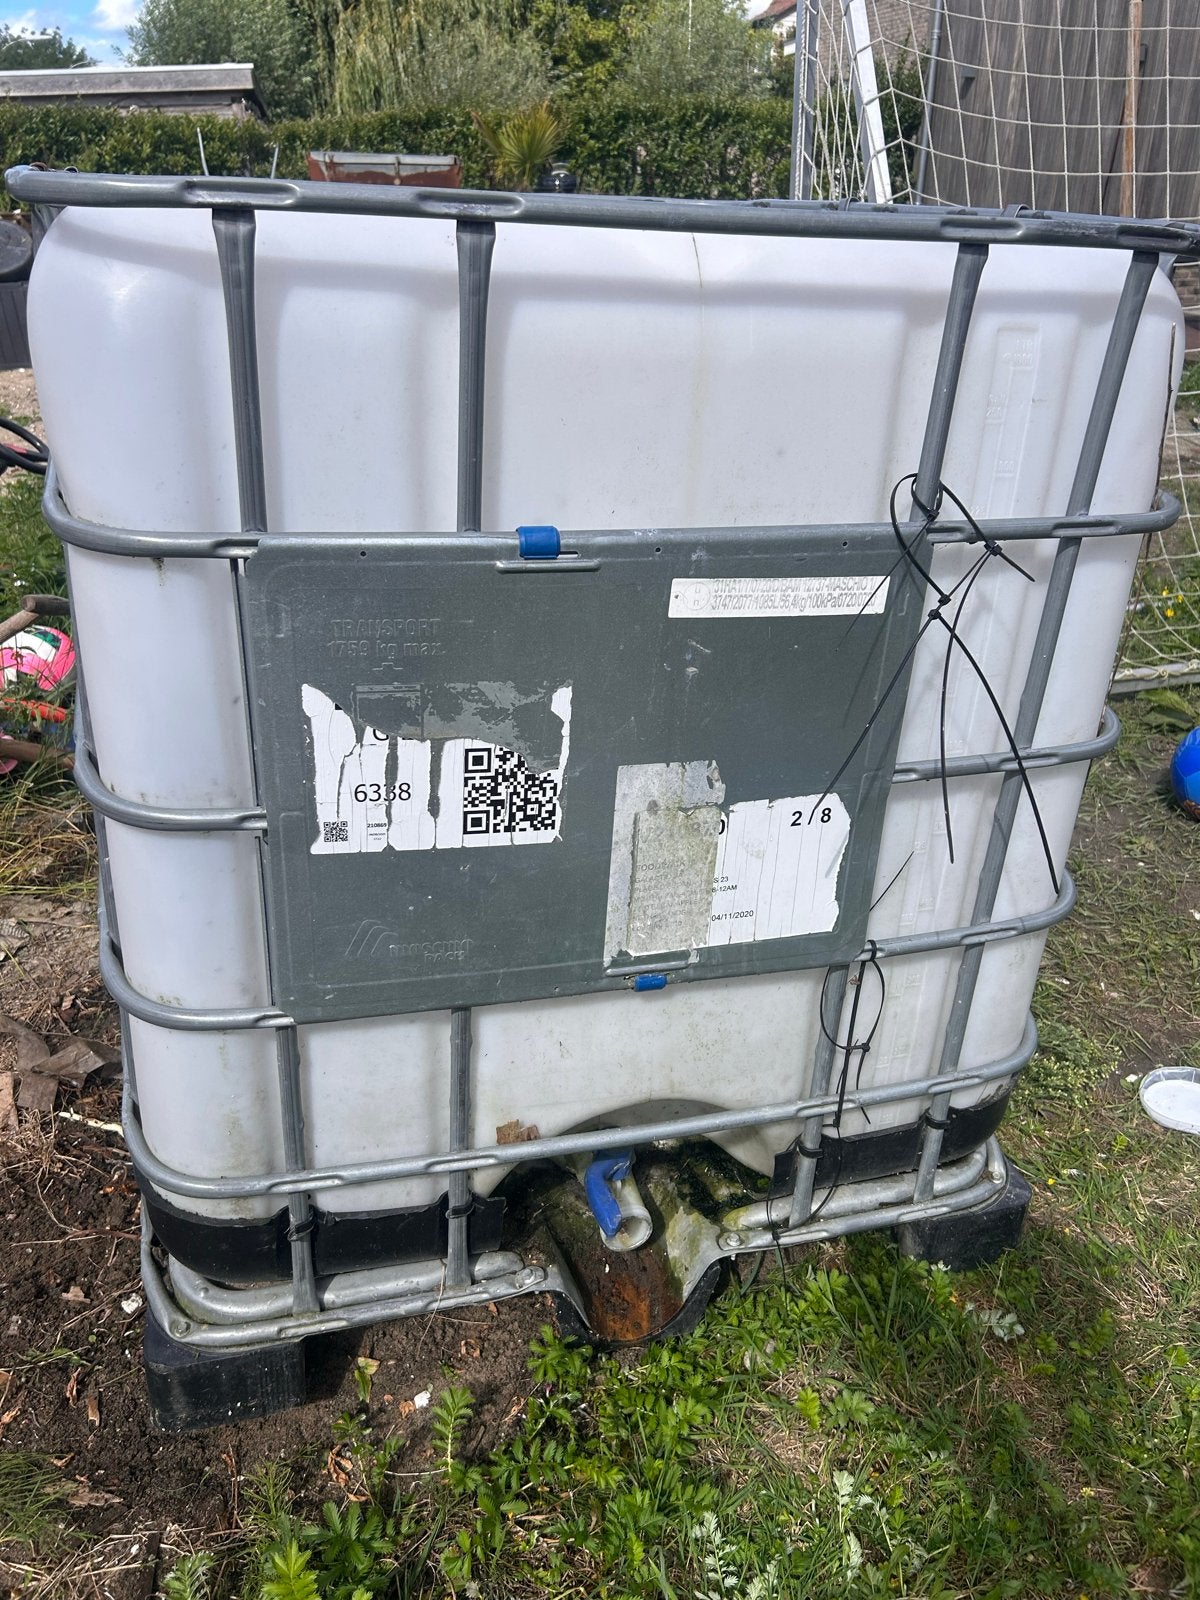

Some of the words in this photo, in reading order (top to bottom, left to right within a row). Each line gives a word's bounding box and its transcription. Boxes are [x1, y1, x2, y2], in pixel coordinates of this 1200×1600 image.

[330, 617, 441, 638] TRANSPORT
[375, 640, 397, 661] kg
[711, 909, 755, 922] 04/11/2020
